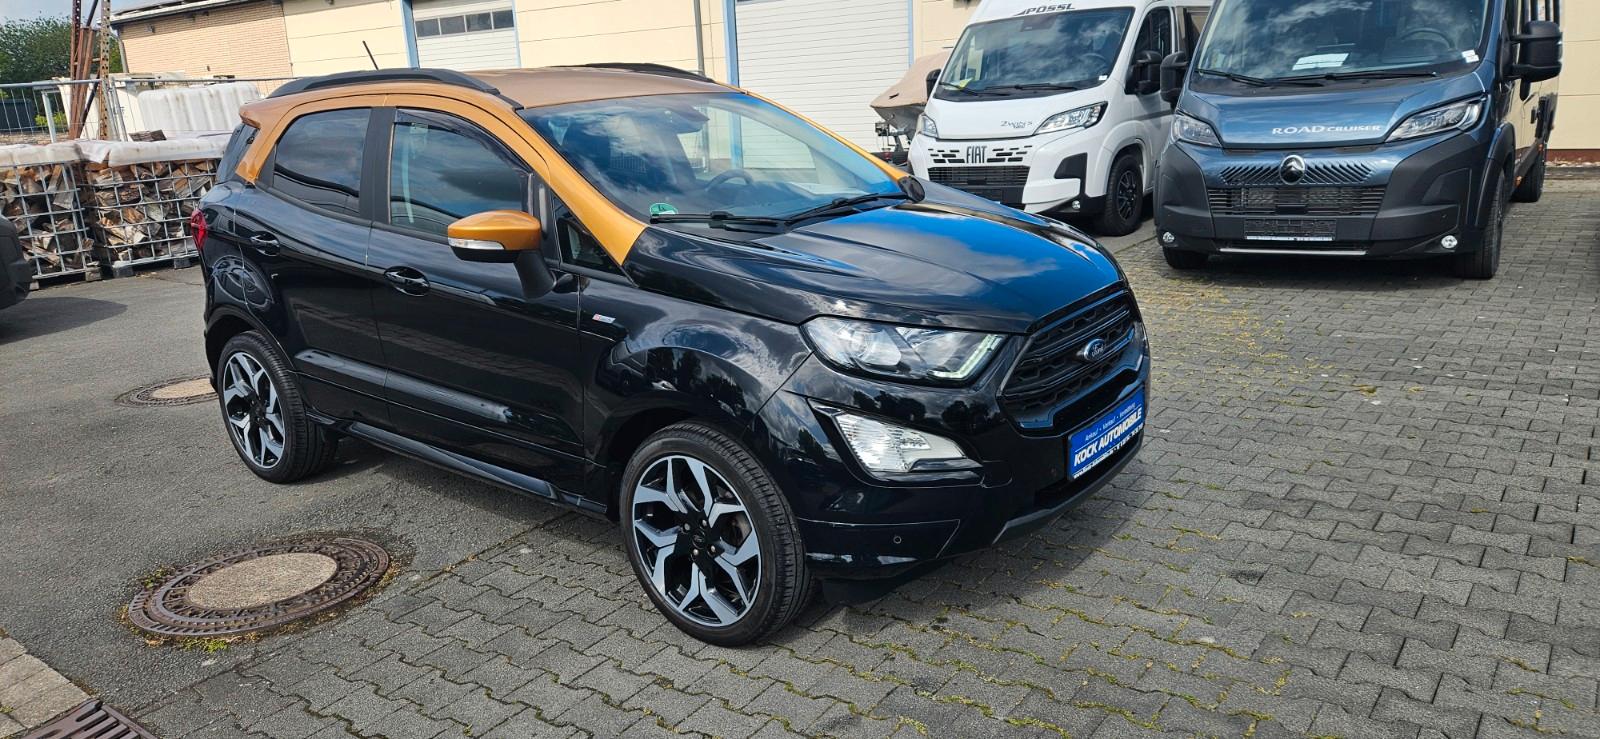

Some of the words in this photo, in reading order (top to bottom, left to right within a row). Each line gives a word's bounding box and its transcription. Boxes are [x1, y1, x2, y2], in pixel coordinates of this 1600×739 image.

[1272, 125, 1325, 135] ROAD
[1327, 124, 1381, 132] CRUISER
[966, 145, 988, 164] FIAT
[1074, 440, 1098, 467] KOCK
[1098, 406, 1143, 452] AUTOMOBILE
